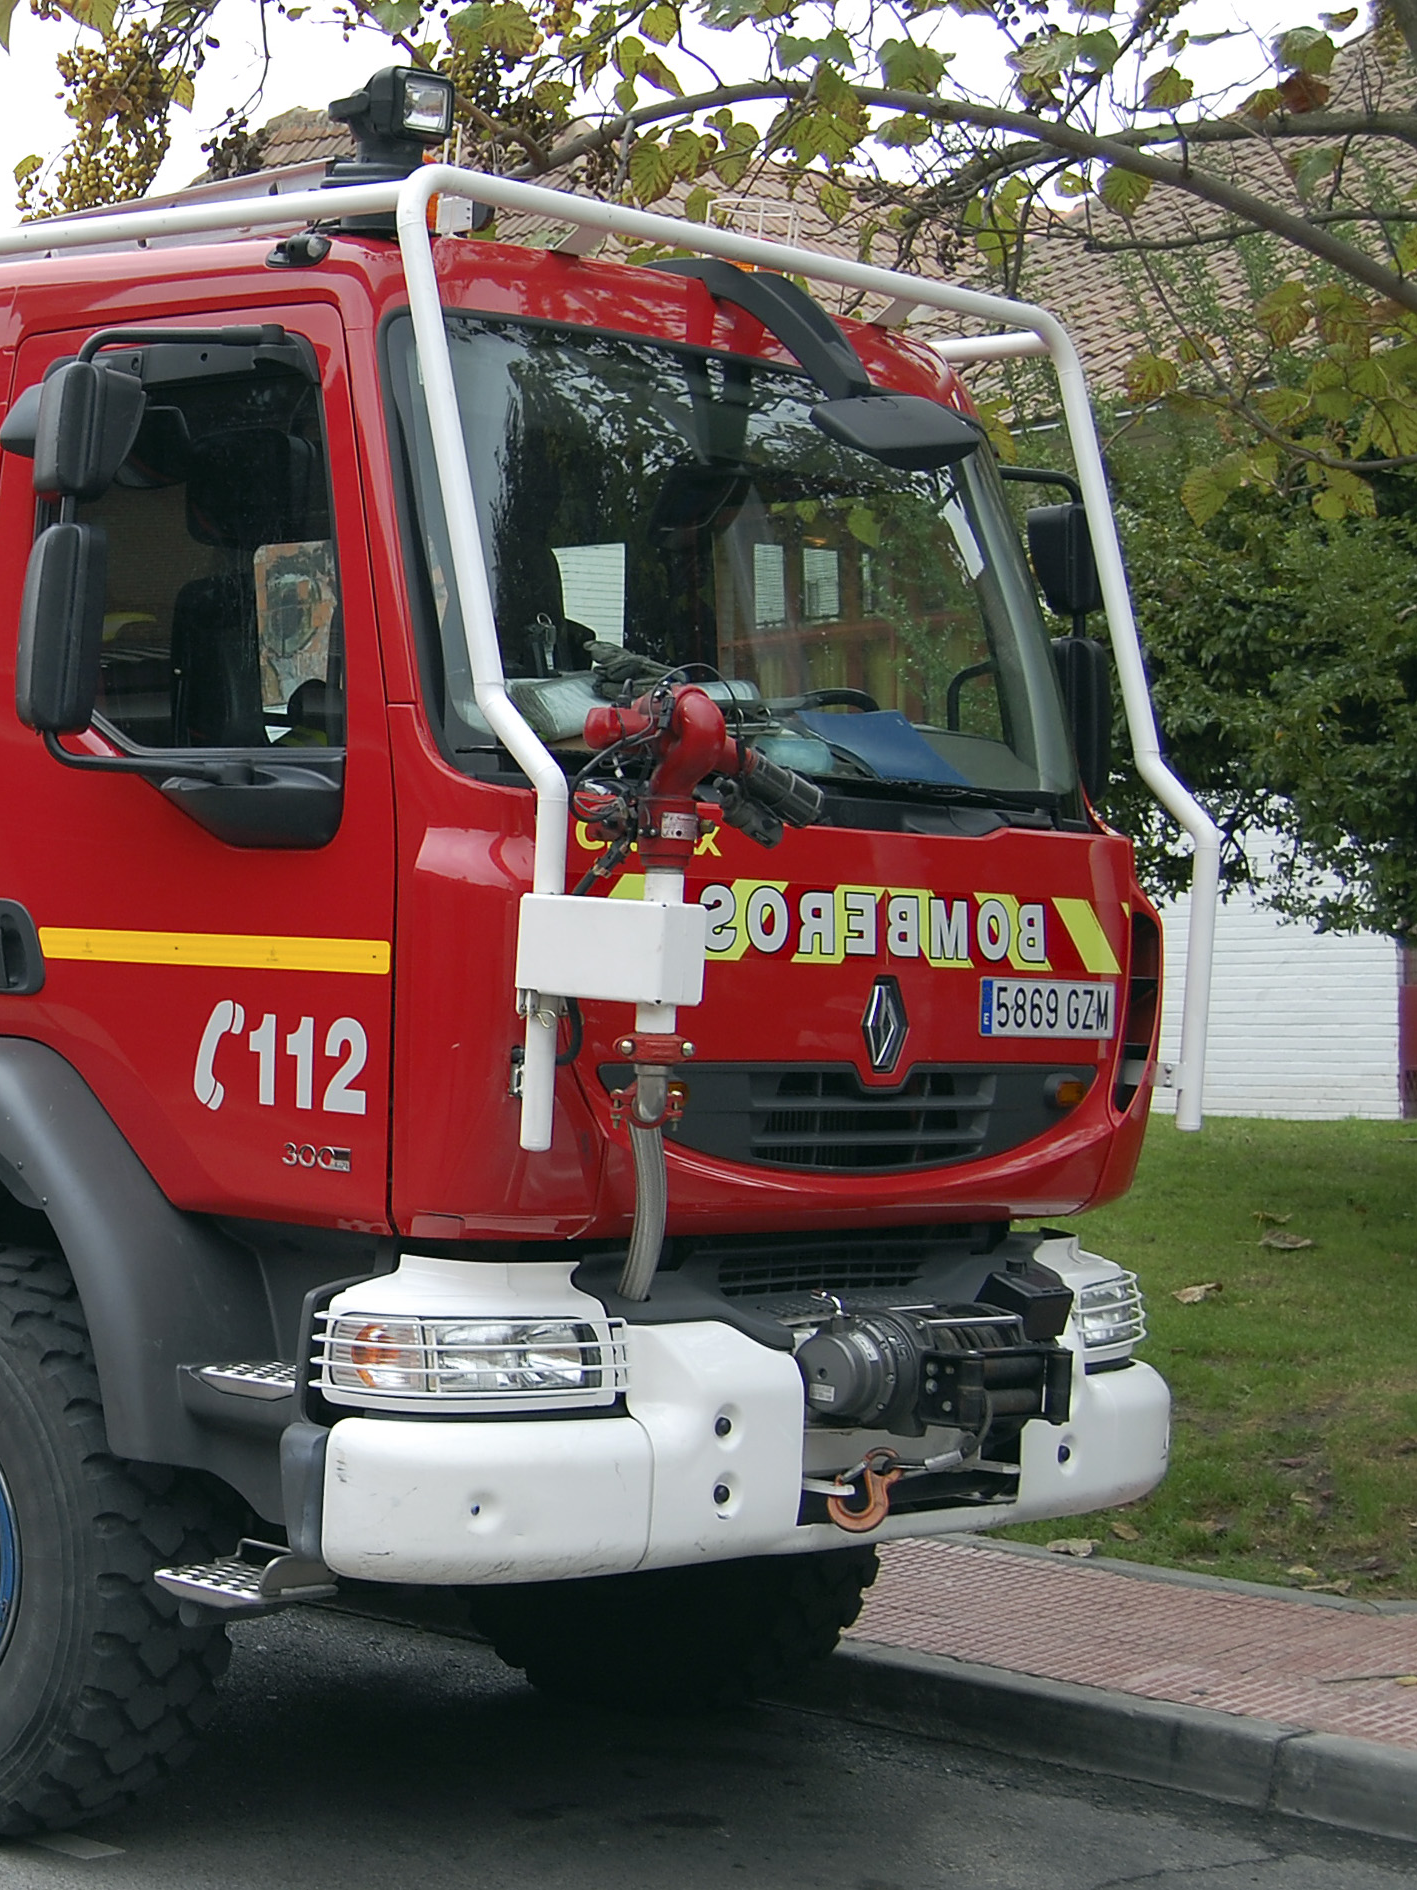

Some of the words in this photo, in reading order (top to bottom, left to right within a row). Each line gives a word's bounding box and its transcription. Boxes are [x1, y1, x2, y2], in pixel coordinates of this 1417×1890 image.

[996, 986, 1059, 1030] 5869
[1067, 988, 1110, 1031] GZM
[248, 1012, 369, 1116] 112
